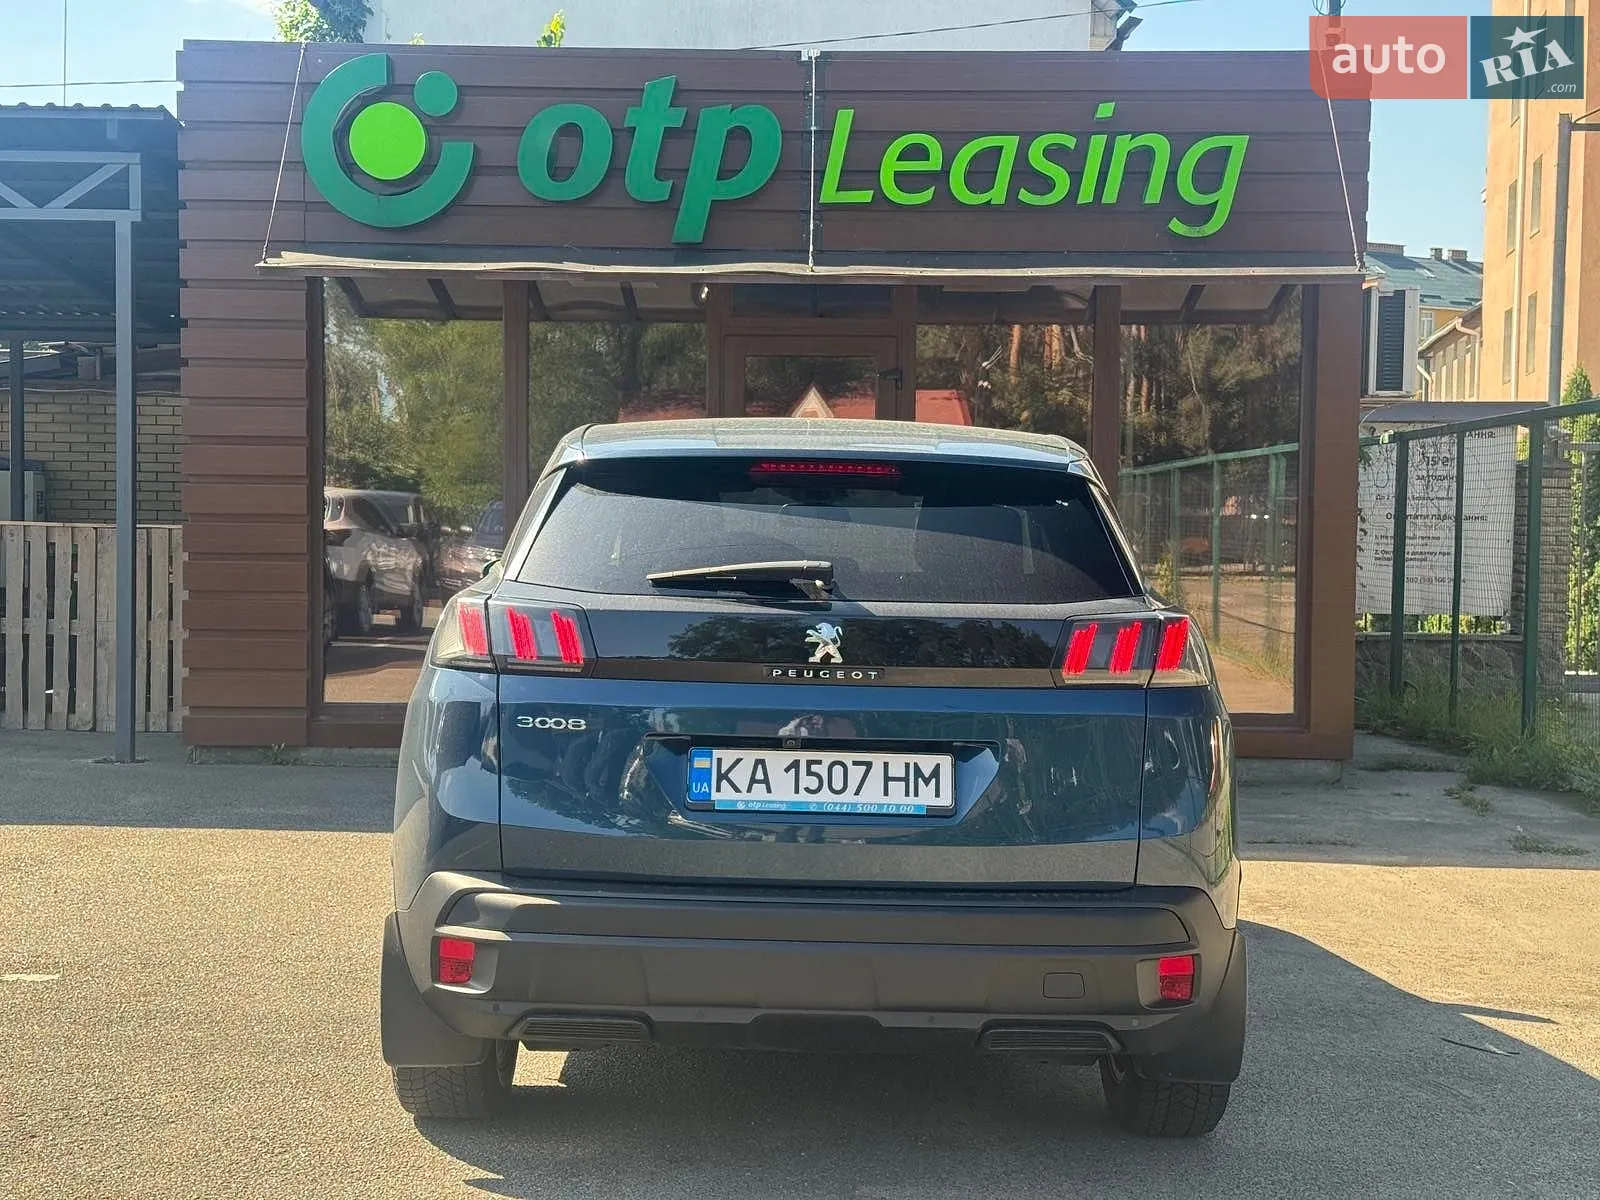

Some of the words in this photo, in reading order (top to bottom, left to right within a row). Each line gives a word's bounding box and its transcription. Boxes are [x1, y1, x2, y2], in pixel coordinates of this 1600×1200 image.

[517, 75, 782, 243] otp
[819, 102, 1250, 238] Leasing
[771, 668, 879, 681] PEUGEOT
[516, 716, 586, 730] 3008
[715, 757, 772, 794] KA
[783, 758, 873, 796] 1507
[883, 761, 941, 799] HM
[692, 781, 710, 794] UA
[823, 802, 852, 812] (044)
[857, 803, 878, 813] 500
[883, 804, 896, 814] 10
[900, 805, 914, 814] 00
